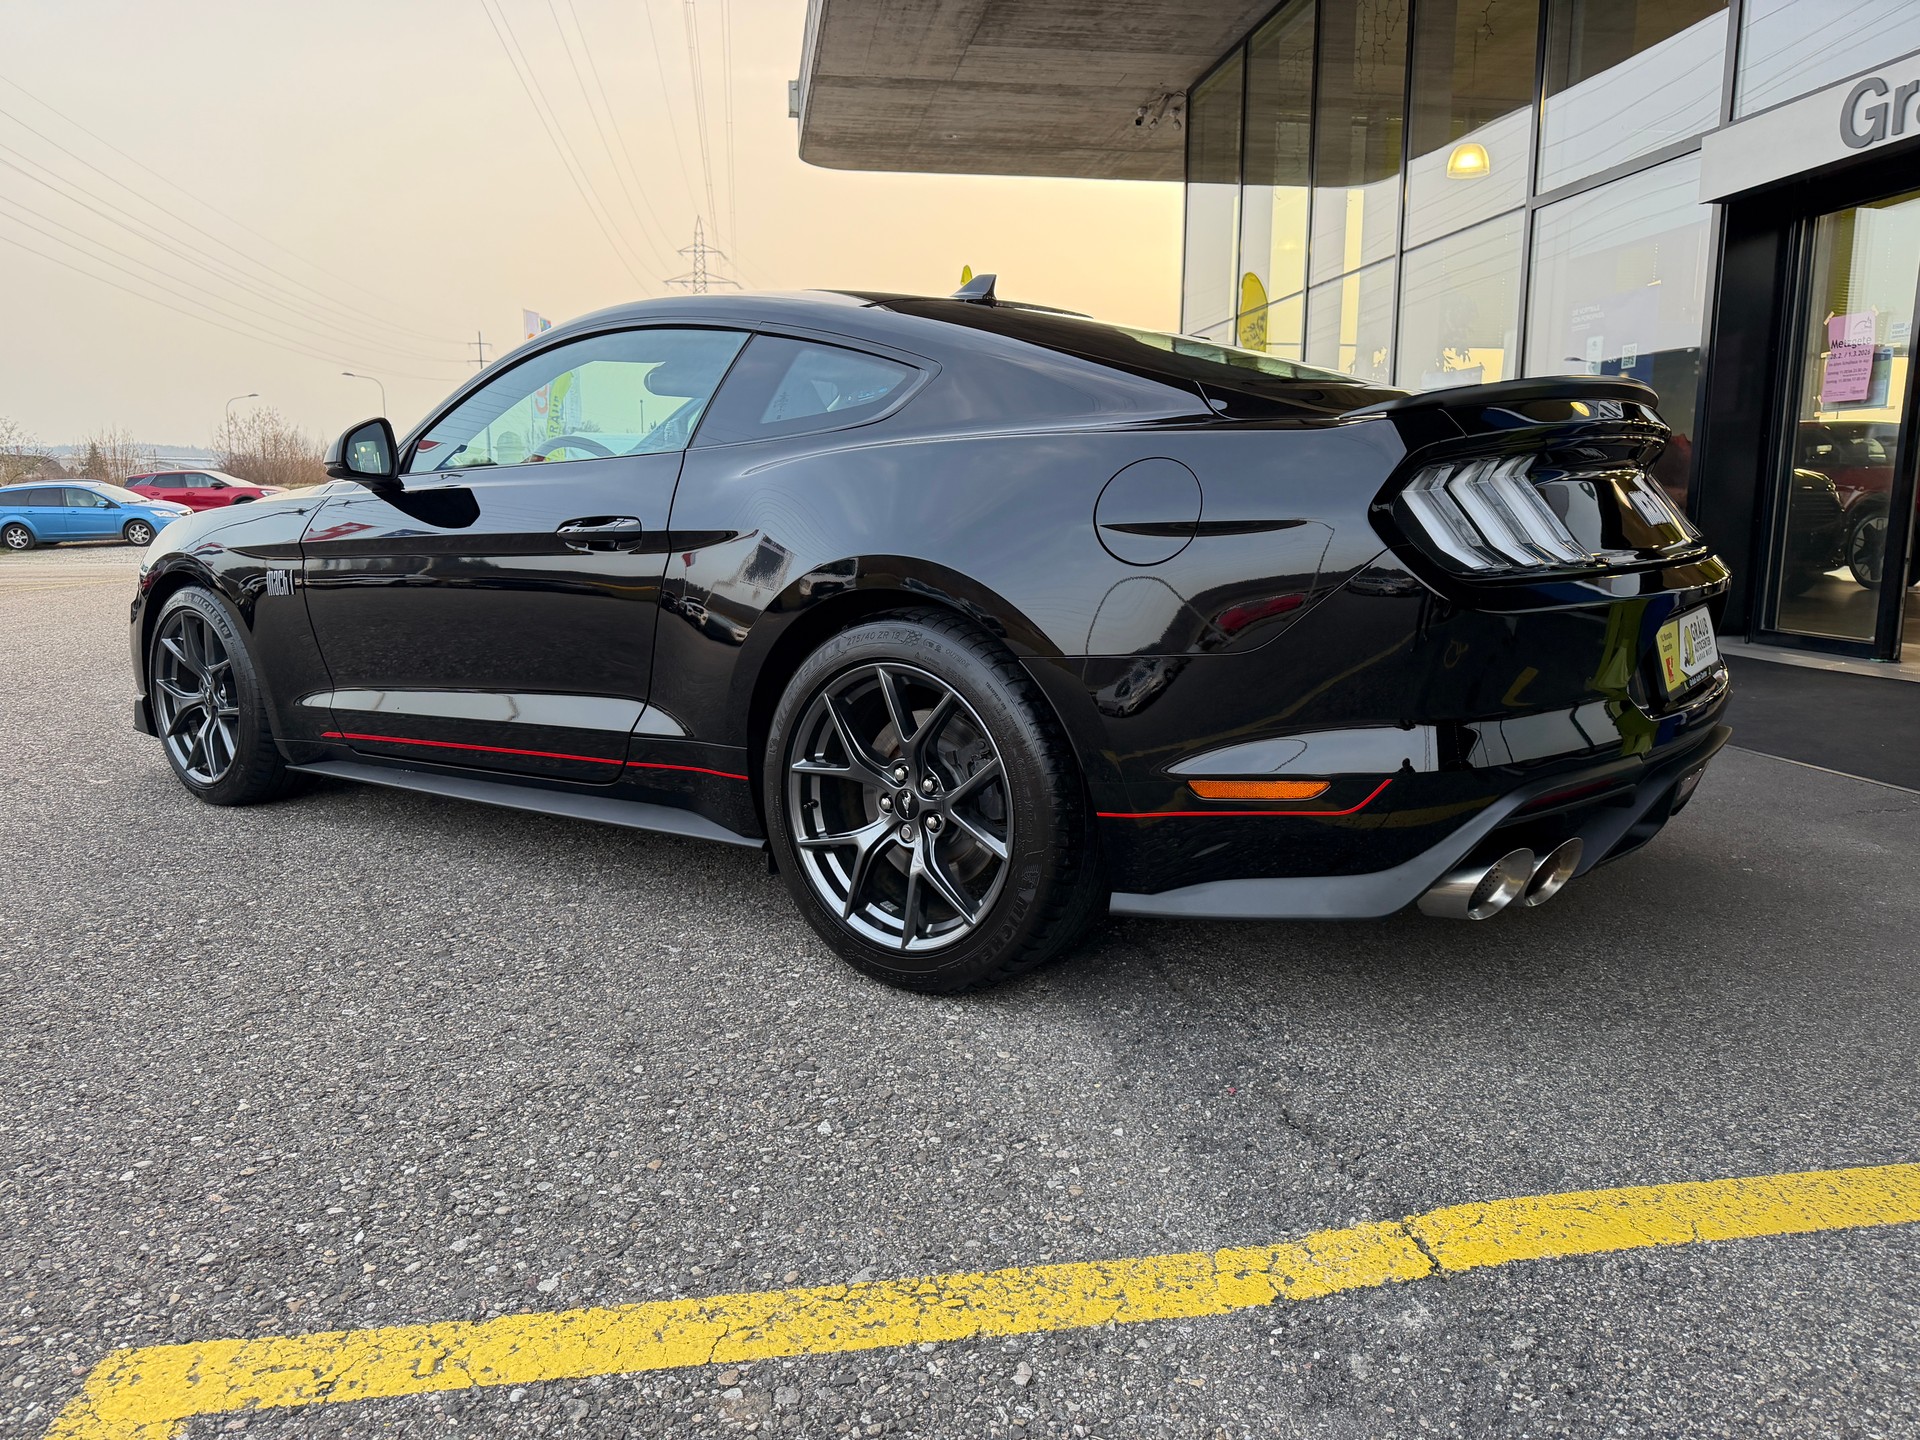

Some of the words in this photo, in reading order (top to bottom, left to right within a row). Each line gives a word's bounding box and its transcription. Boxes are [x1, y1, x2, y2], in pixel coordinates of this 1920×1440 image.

[1840, 77, 1920, 149] Gr
[1831, 337, 1872, 349] Metzgete
[193, 595, 230, 637] MICHELIN
[846, 632, 875, 647] 275/40
[876, 631, 889, 640] ZR
[890, 631, 900, 640] 19
[776, 639, 841, 730] MICHELIN
